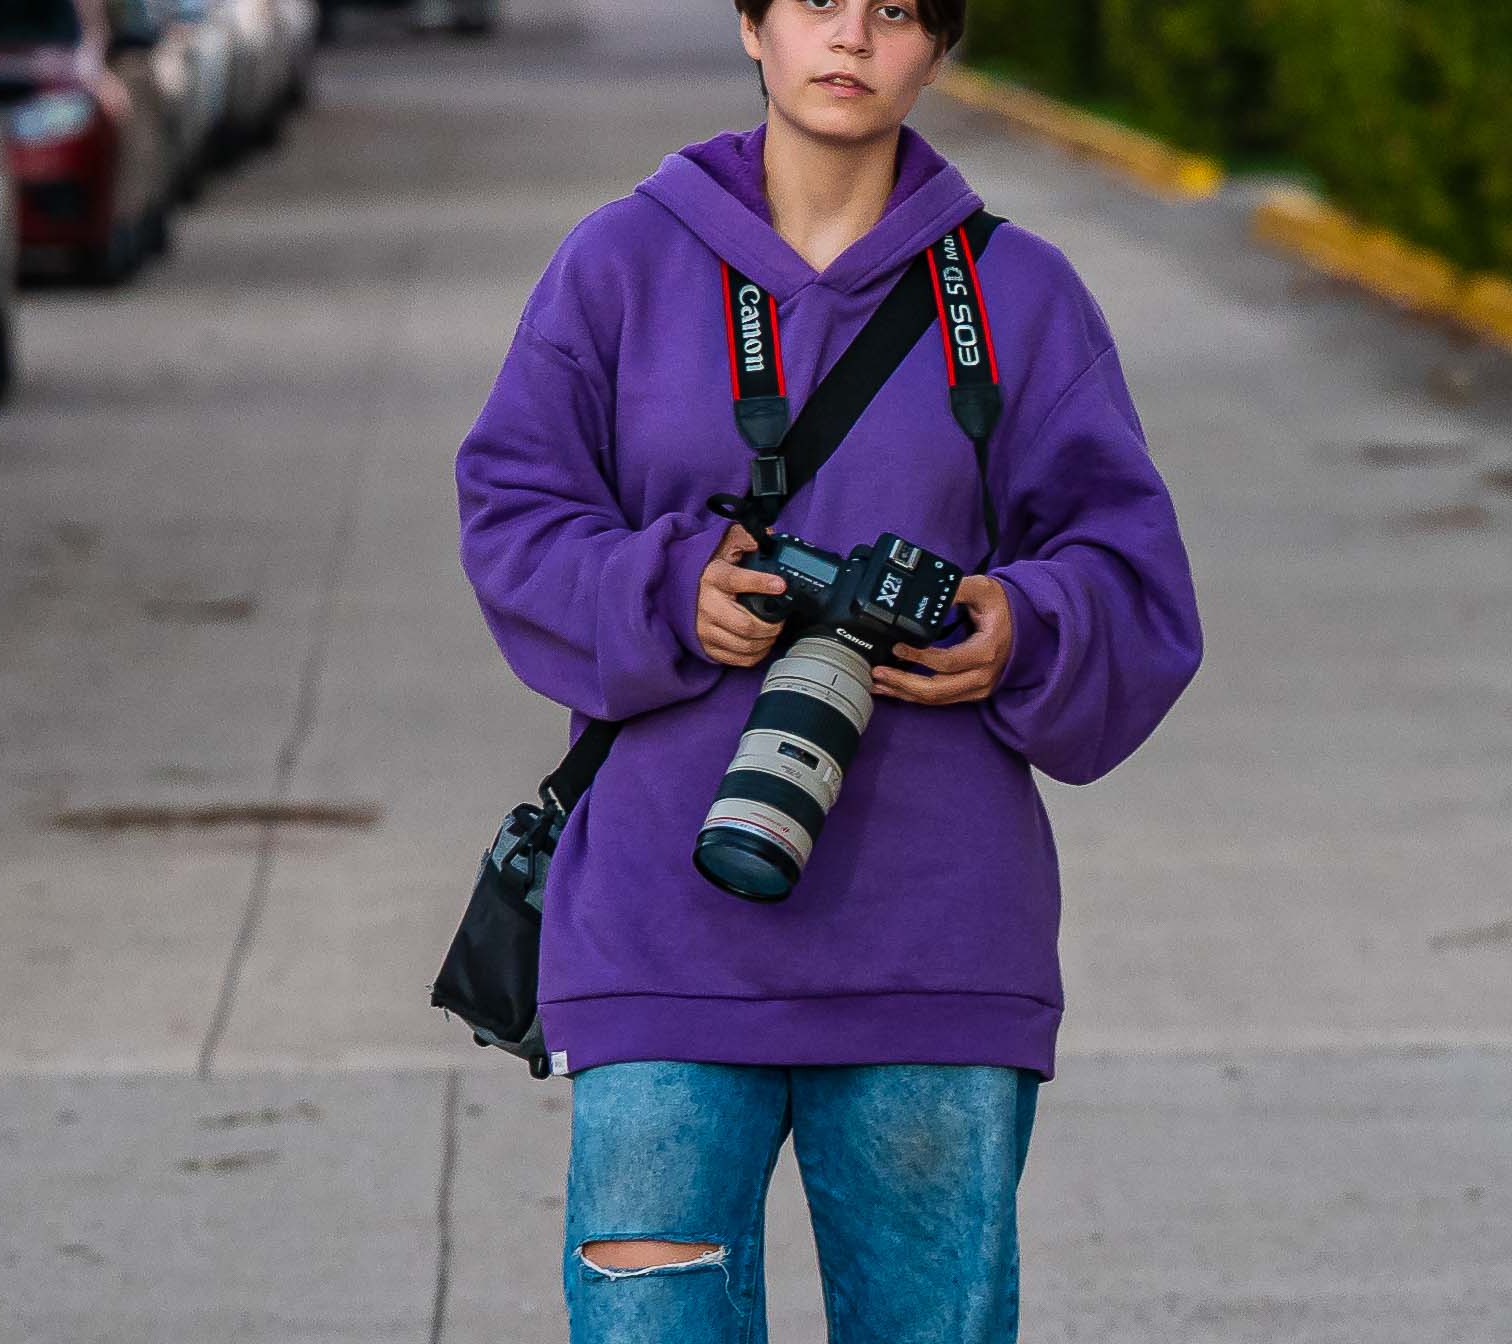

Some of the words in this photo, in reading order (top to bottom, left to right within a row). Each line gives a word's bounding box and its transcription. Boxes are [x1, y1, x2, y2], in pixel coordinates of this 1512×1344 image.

[943, 265, 968, 296] 5D
[738, 284, 765, 372] Canon
[950, 303, 980, 366] EOS
[835, 627, 874, 650] Canon
